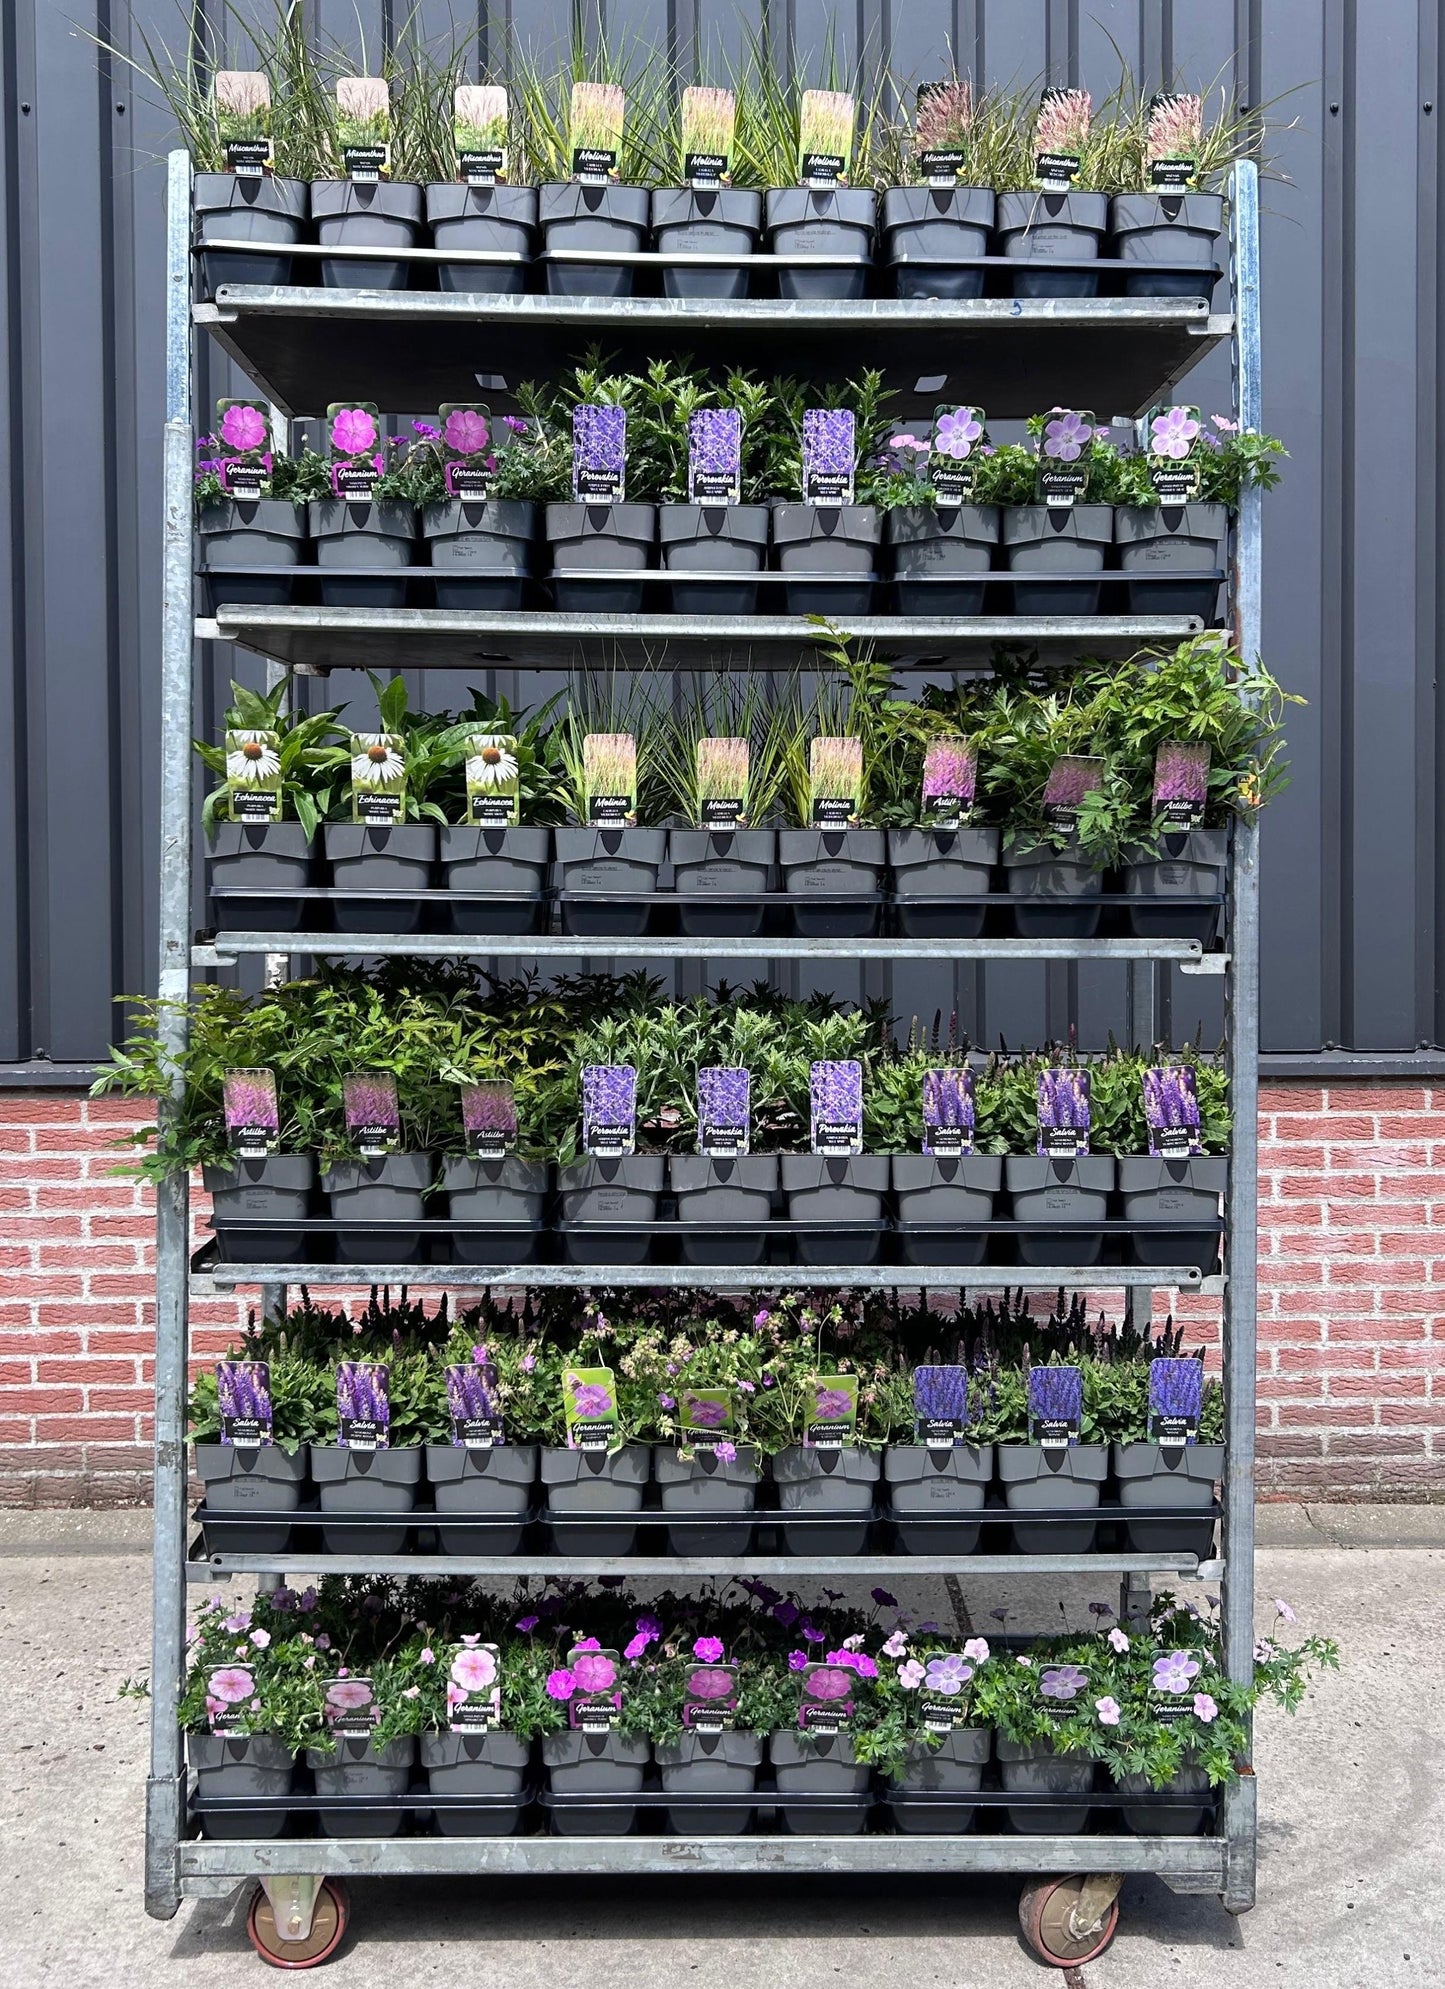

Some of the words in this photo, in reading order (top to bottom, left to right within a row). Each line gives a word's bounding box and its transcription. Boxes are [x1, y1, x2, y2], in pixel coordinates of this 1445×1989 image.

[229, 144, 268, 153] Miscanthus
[346, 149, 385, 157] Miscanthus
[463, 154, 502, 162] Miscanthus
[579, 151, 611, 161] Molinia
[691, 155, 723, 166] Molinia
[924, 153, 962, 162] Miscanthus
[808, 156, 840, 167] Molinia
[1038, 156, 1078, 167] Miscanthus
[1154, 163, 1193, 171] Miscanthus
[226, 465, 266, 475] Geranium
[338, 468, 378, 478] Geranium
[452, 467, 492, 477] Geranium
[581, 471, 618, 481] Perovskia
[696, 474, 734, 484] Perovskia
[810, 474, 848, 484] Perovskia
[932, 470, 972, 482] Geranium
[1042, 473, 1083, 483] Geranium
[1153, 471, 1194, 482] Geranium
[234, 793, 275, 802] Echinacea
[358, 795, 399, 804] Echinacea
[473, 797, 513, 806] Echinacea
[595, 798, 627, 807] Molinia
[707, 800, 739, 809] Molinia
[819, 801, 851, 809] Molinia
[1163, 801, 1192, 810] Astilbe
[238, 1127, 266, 1135] Astilbe
[359, 1126, 387, 1134] Astilbe
[591, 1126, 628, 1135] Perovskia
[706, 1126, 743, 1136] Perovskia
[819, 1124, 856, 1134] Perovskia
[935, 1127, 961, 1135] Salvia
[1050, 1128, 1076, 1137] Salvia
[1161, 1128, 1187, 1137] Salvia
[233, 1418, 259, 1427] Salvia
[350, 1420, 376, 1430] Salvia
[464, 1419, 490, 1428] Salvia
[927, 1420, 953, 1428] Salvia
[1042, 1420, 1068, 1428] Salvia
[1161, 1416, 1187, 1425] Salvia
[573, 1423, 613, 1432] Geranium
[810, 1424, 850, 1432] Geranium
[454, 1703, 494, 1713] Geranium
[576, 1704, 616, 1712] Geranium
[690, 1707, 730, 1716] Geranium
[807, 1708, 846, 1717] Geranium
[922, 1703, 962, 1713] Geranium
[1154, 1704, 1193, 1713] Geranium
[216, 1712, 241, 1721] Geran
[335, 1715, 375, 1723] Geranium
